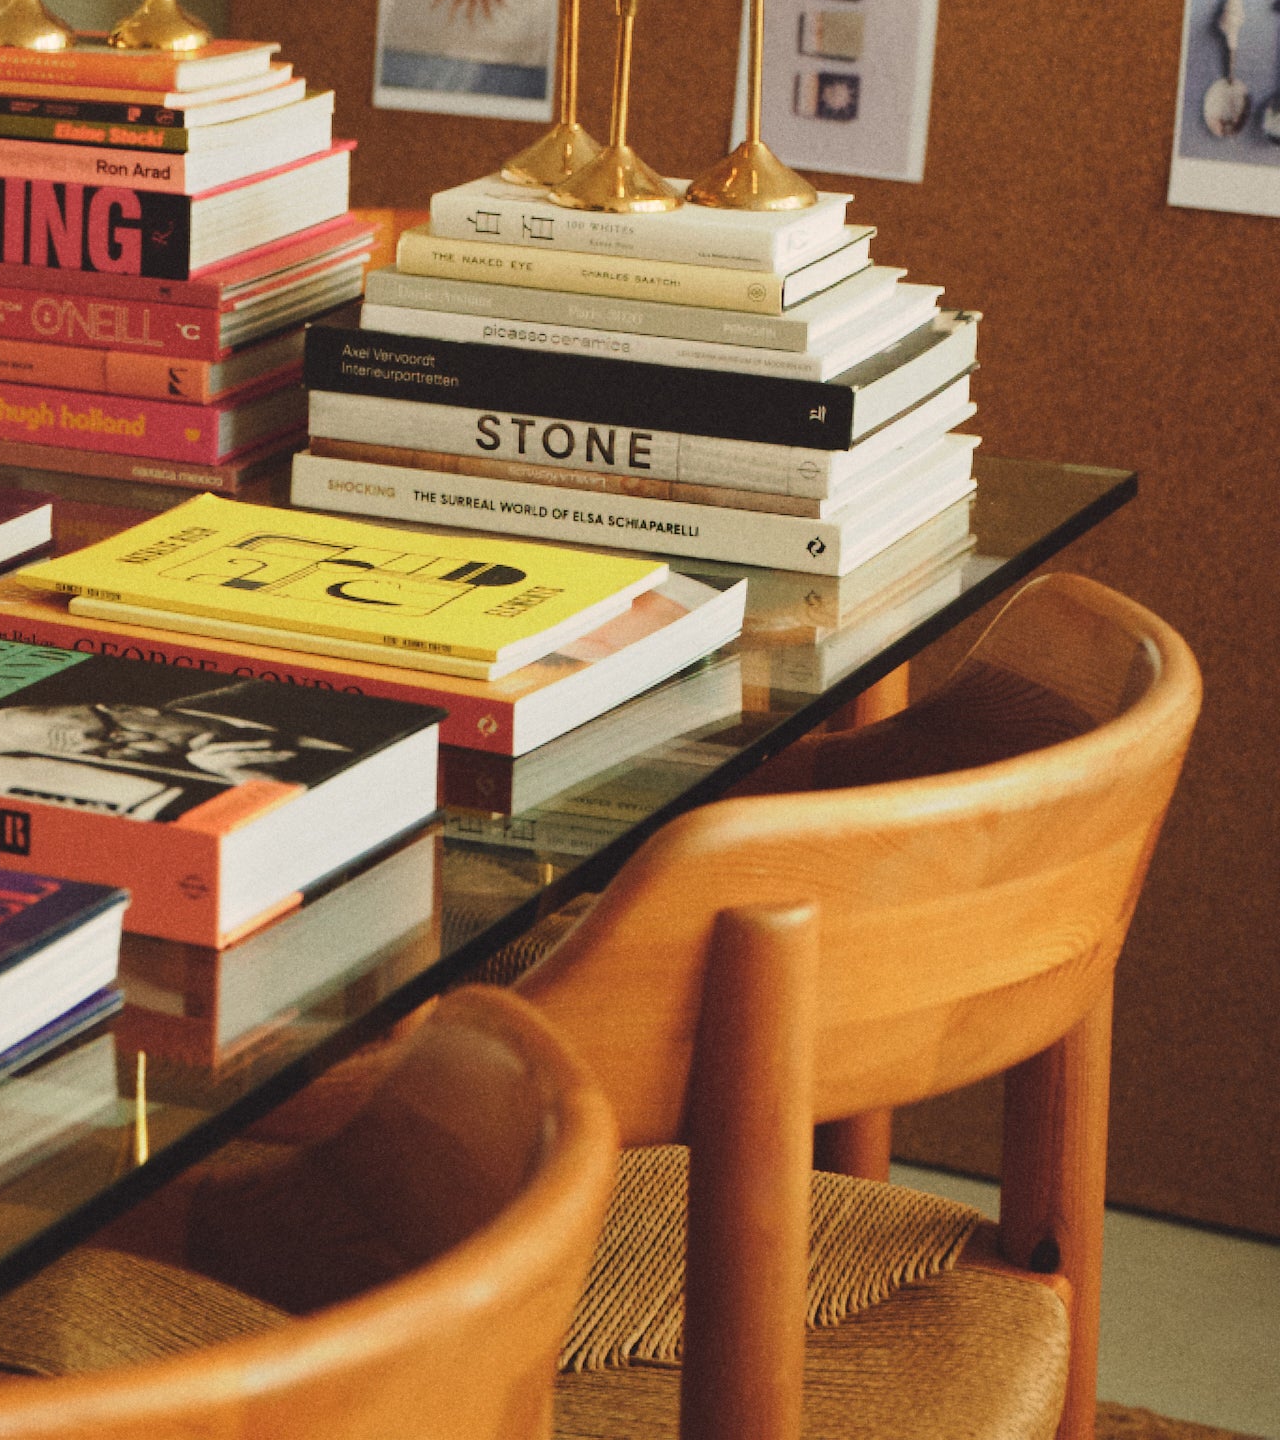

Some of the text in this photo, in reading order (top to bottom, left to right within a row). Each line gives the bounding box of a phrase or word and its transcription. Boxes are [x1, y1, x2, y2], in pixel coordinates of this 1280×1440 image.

[96, 160, 171, 180] Ron Arad
[565, 220, 586, 231] 100
[432, 250, 534, 272] THE NAKED EYE
[581, 268, 682, 288] CHARLES SAATCHI
[482, 323, 631, 354] picasso ceramics
[341, 343, 436, 368] Axel Vervoordt
[342, 361, 460, 388] Interieurportretten
[60, 404, 146, 438] holland
[475, 414, 653, 470] STONE
[327, 478, 700, 537] SHOCKING THE SURREAL WORLD OF ELSA SCHIAPARELLI
